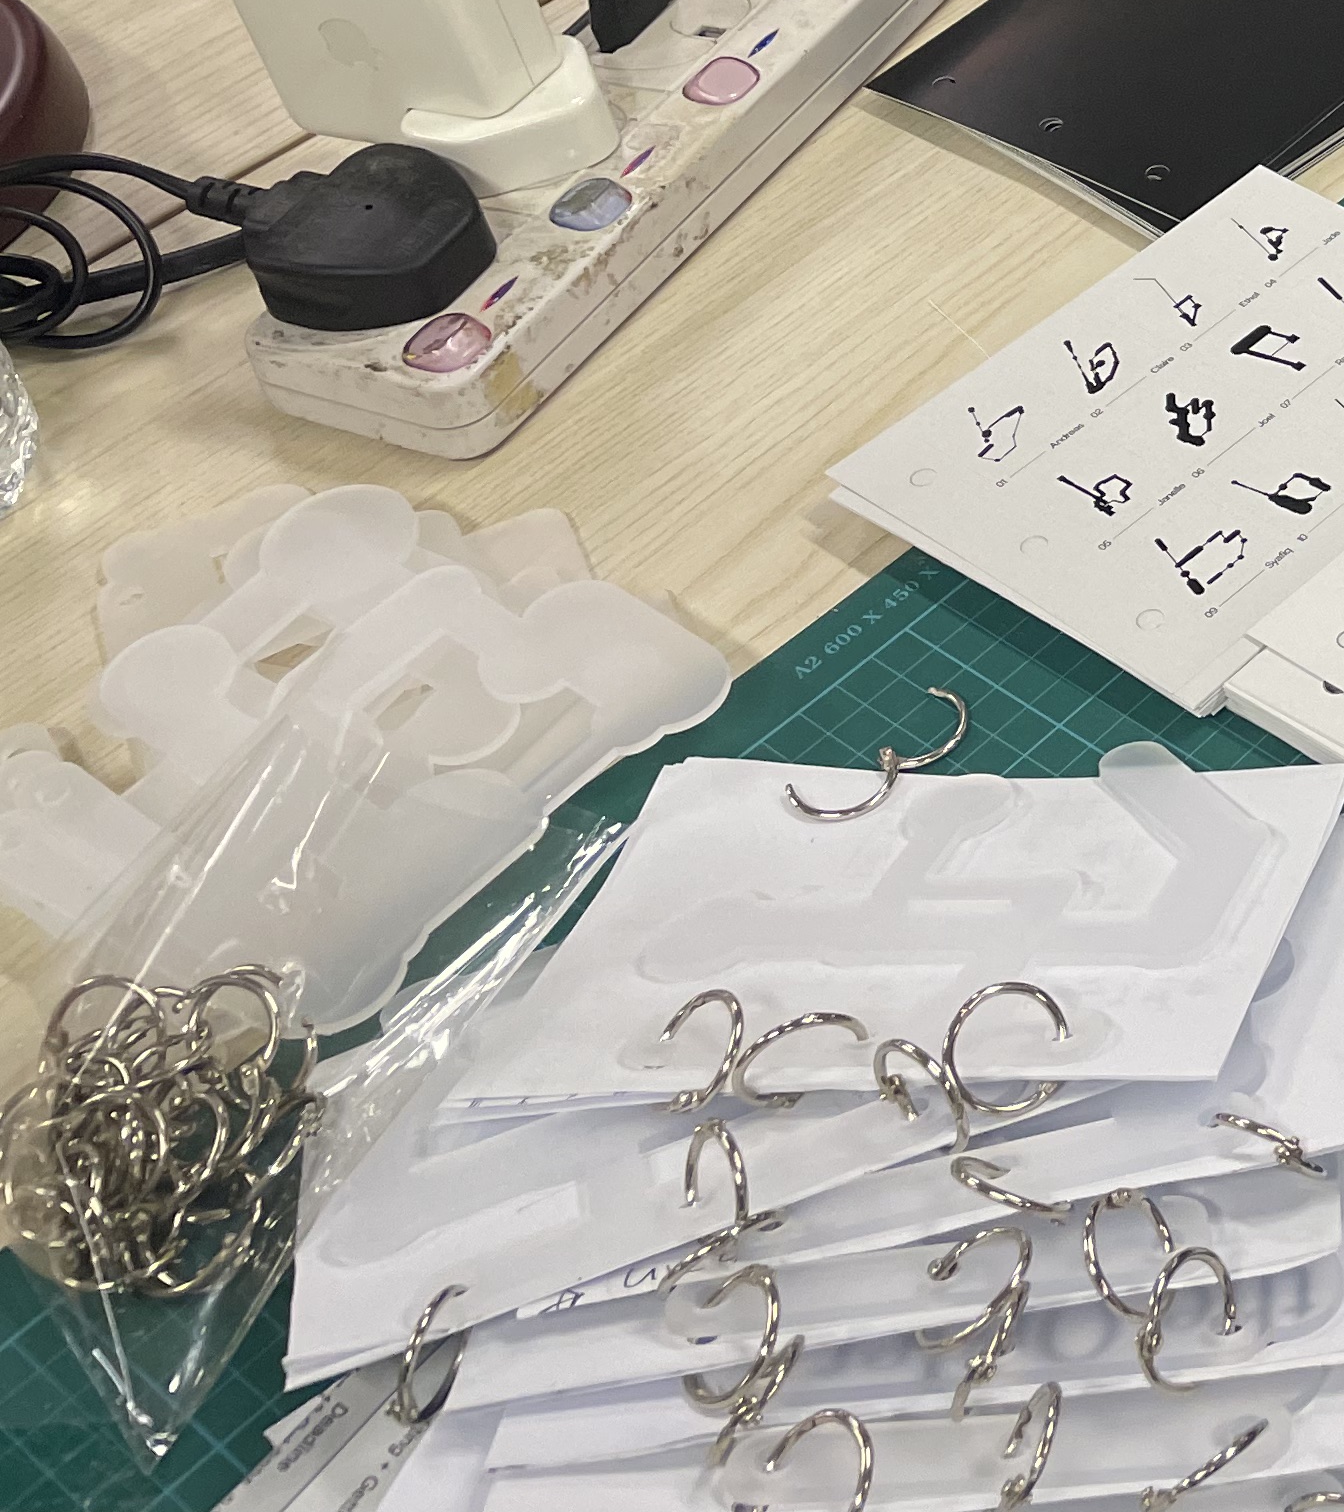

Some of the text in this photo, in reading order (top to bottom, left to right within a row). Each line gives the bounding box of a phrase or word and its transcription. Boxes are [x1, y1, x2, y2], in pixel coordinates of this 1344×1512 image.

[1321, 230, 1341, 247] Jade
[1238, 291, 1261, 309] Ethel
[1150, 355, 1176, 375] Claire
[1257, 412, 1277, 429] Joel
[1050, 422, 1085, 449] Andreas
[1156, 482, 1187, 508] Janelle
[1264, 546, 1296, 570] Syafiq
[795, 652, 825, 681] A2
[823, 622, 864, 656] 600
[883, 578, 921, 608] 450
[277, 1402, 348, 1472] Deadline
